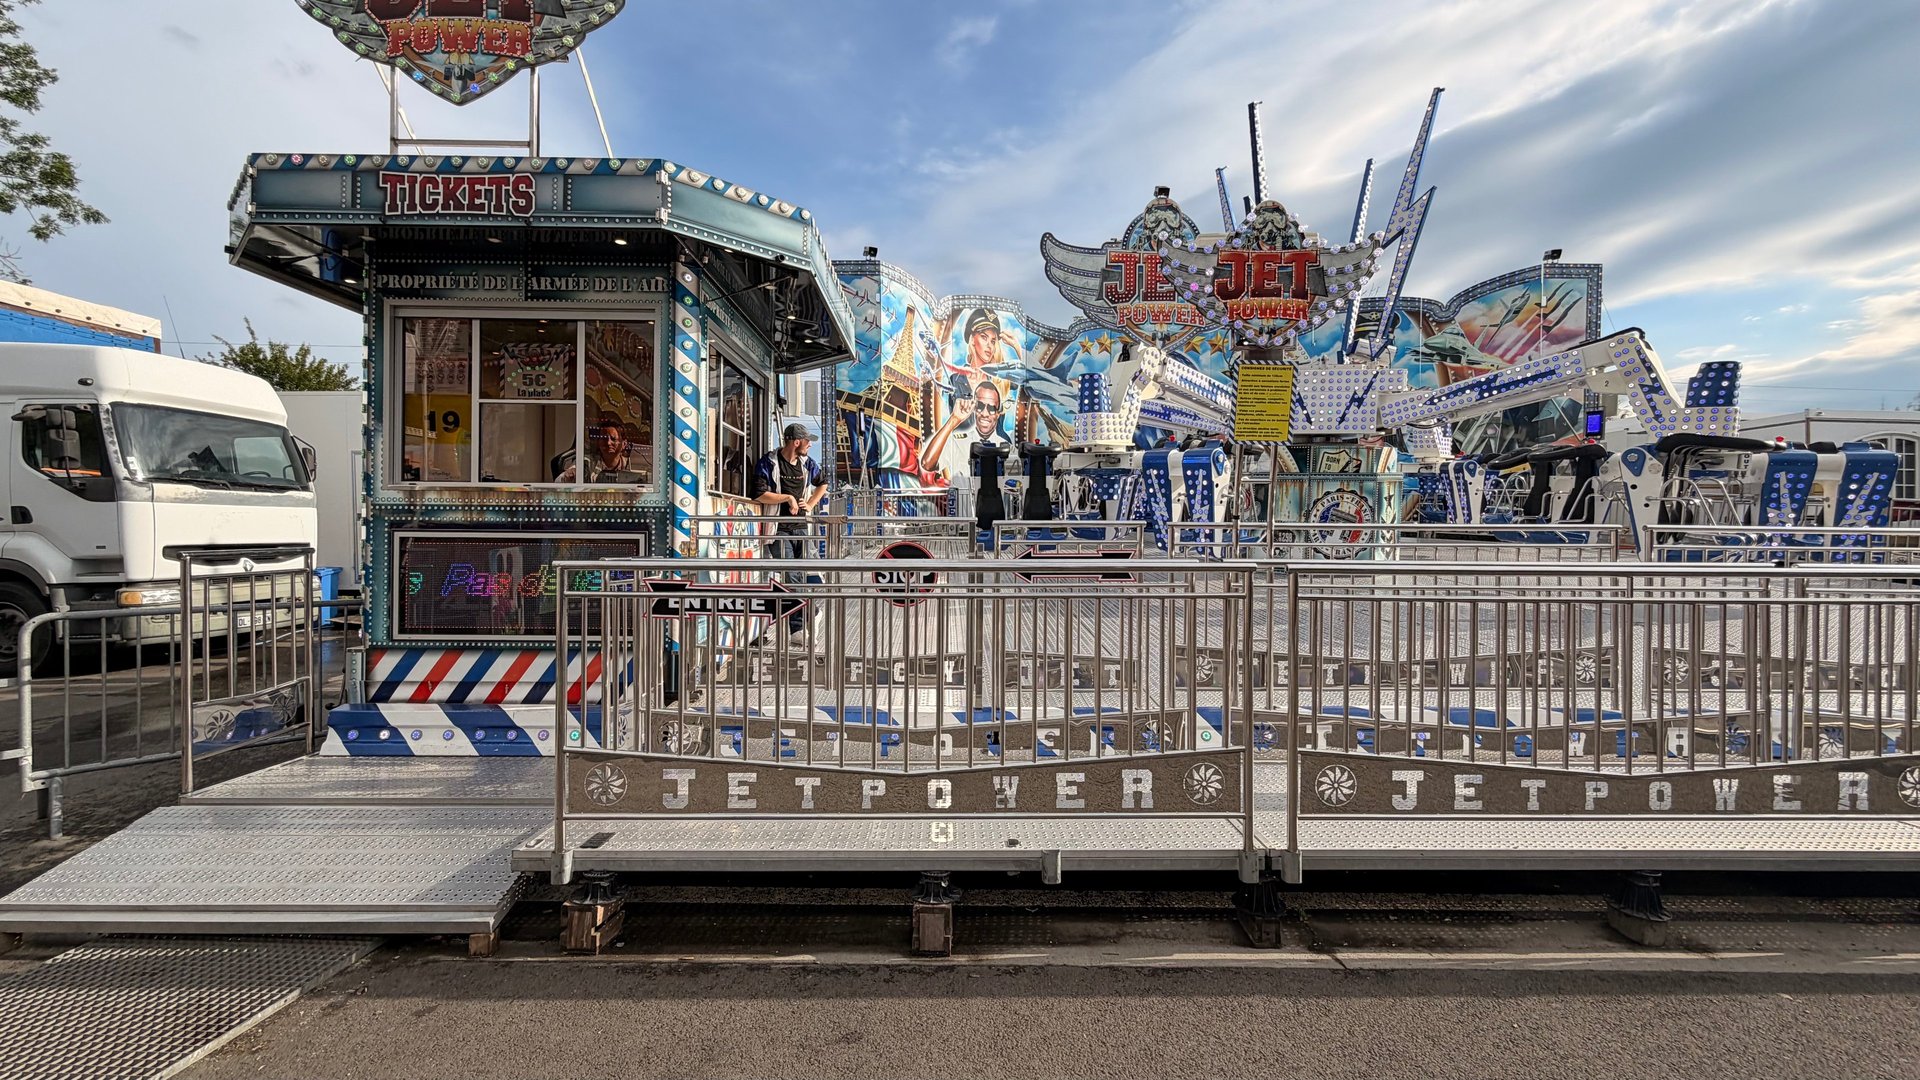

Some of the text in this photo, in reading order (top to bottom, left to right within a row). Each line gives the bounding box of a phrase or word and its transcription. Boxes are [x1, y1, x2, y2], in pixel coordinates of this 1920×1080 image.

[386, 18, 532, 57] POWER
[379, 171, 536, 217] TICKETS
[376, 272, 478, 290] PROPRIÉTÉ
[484, 275, 508, 290] DE
[594, 277, 618, 292] DE
[622, 277, 669, 293] L'AIR
[1103, 250, 1177, 305] JE
[1213, 250, 1320, 302] JET
[1116, 301, 1206, 328] POWER
[1226, 299, 1310, 321] POWER
[428, 411, 460, 433] 19
[1320, 494, 1345, 508] PARIS
